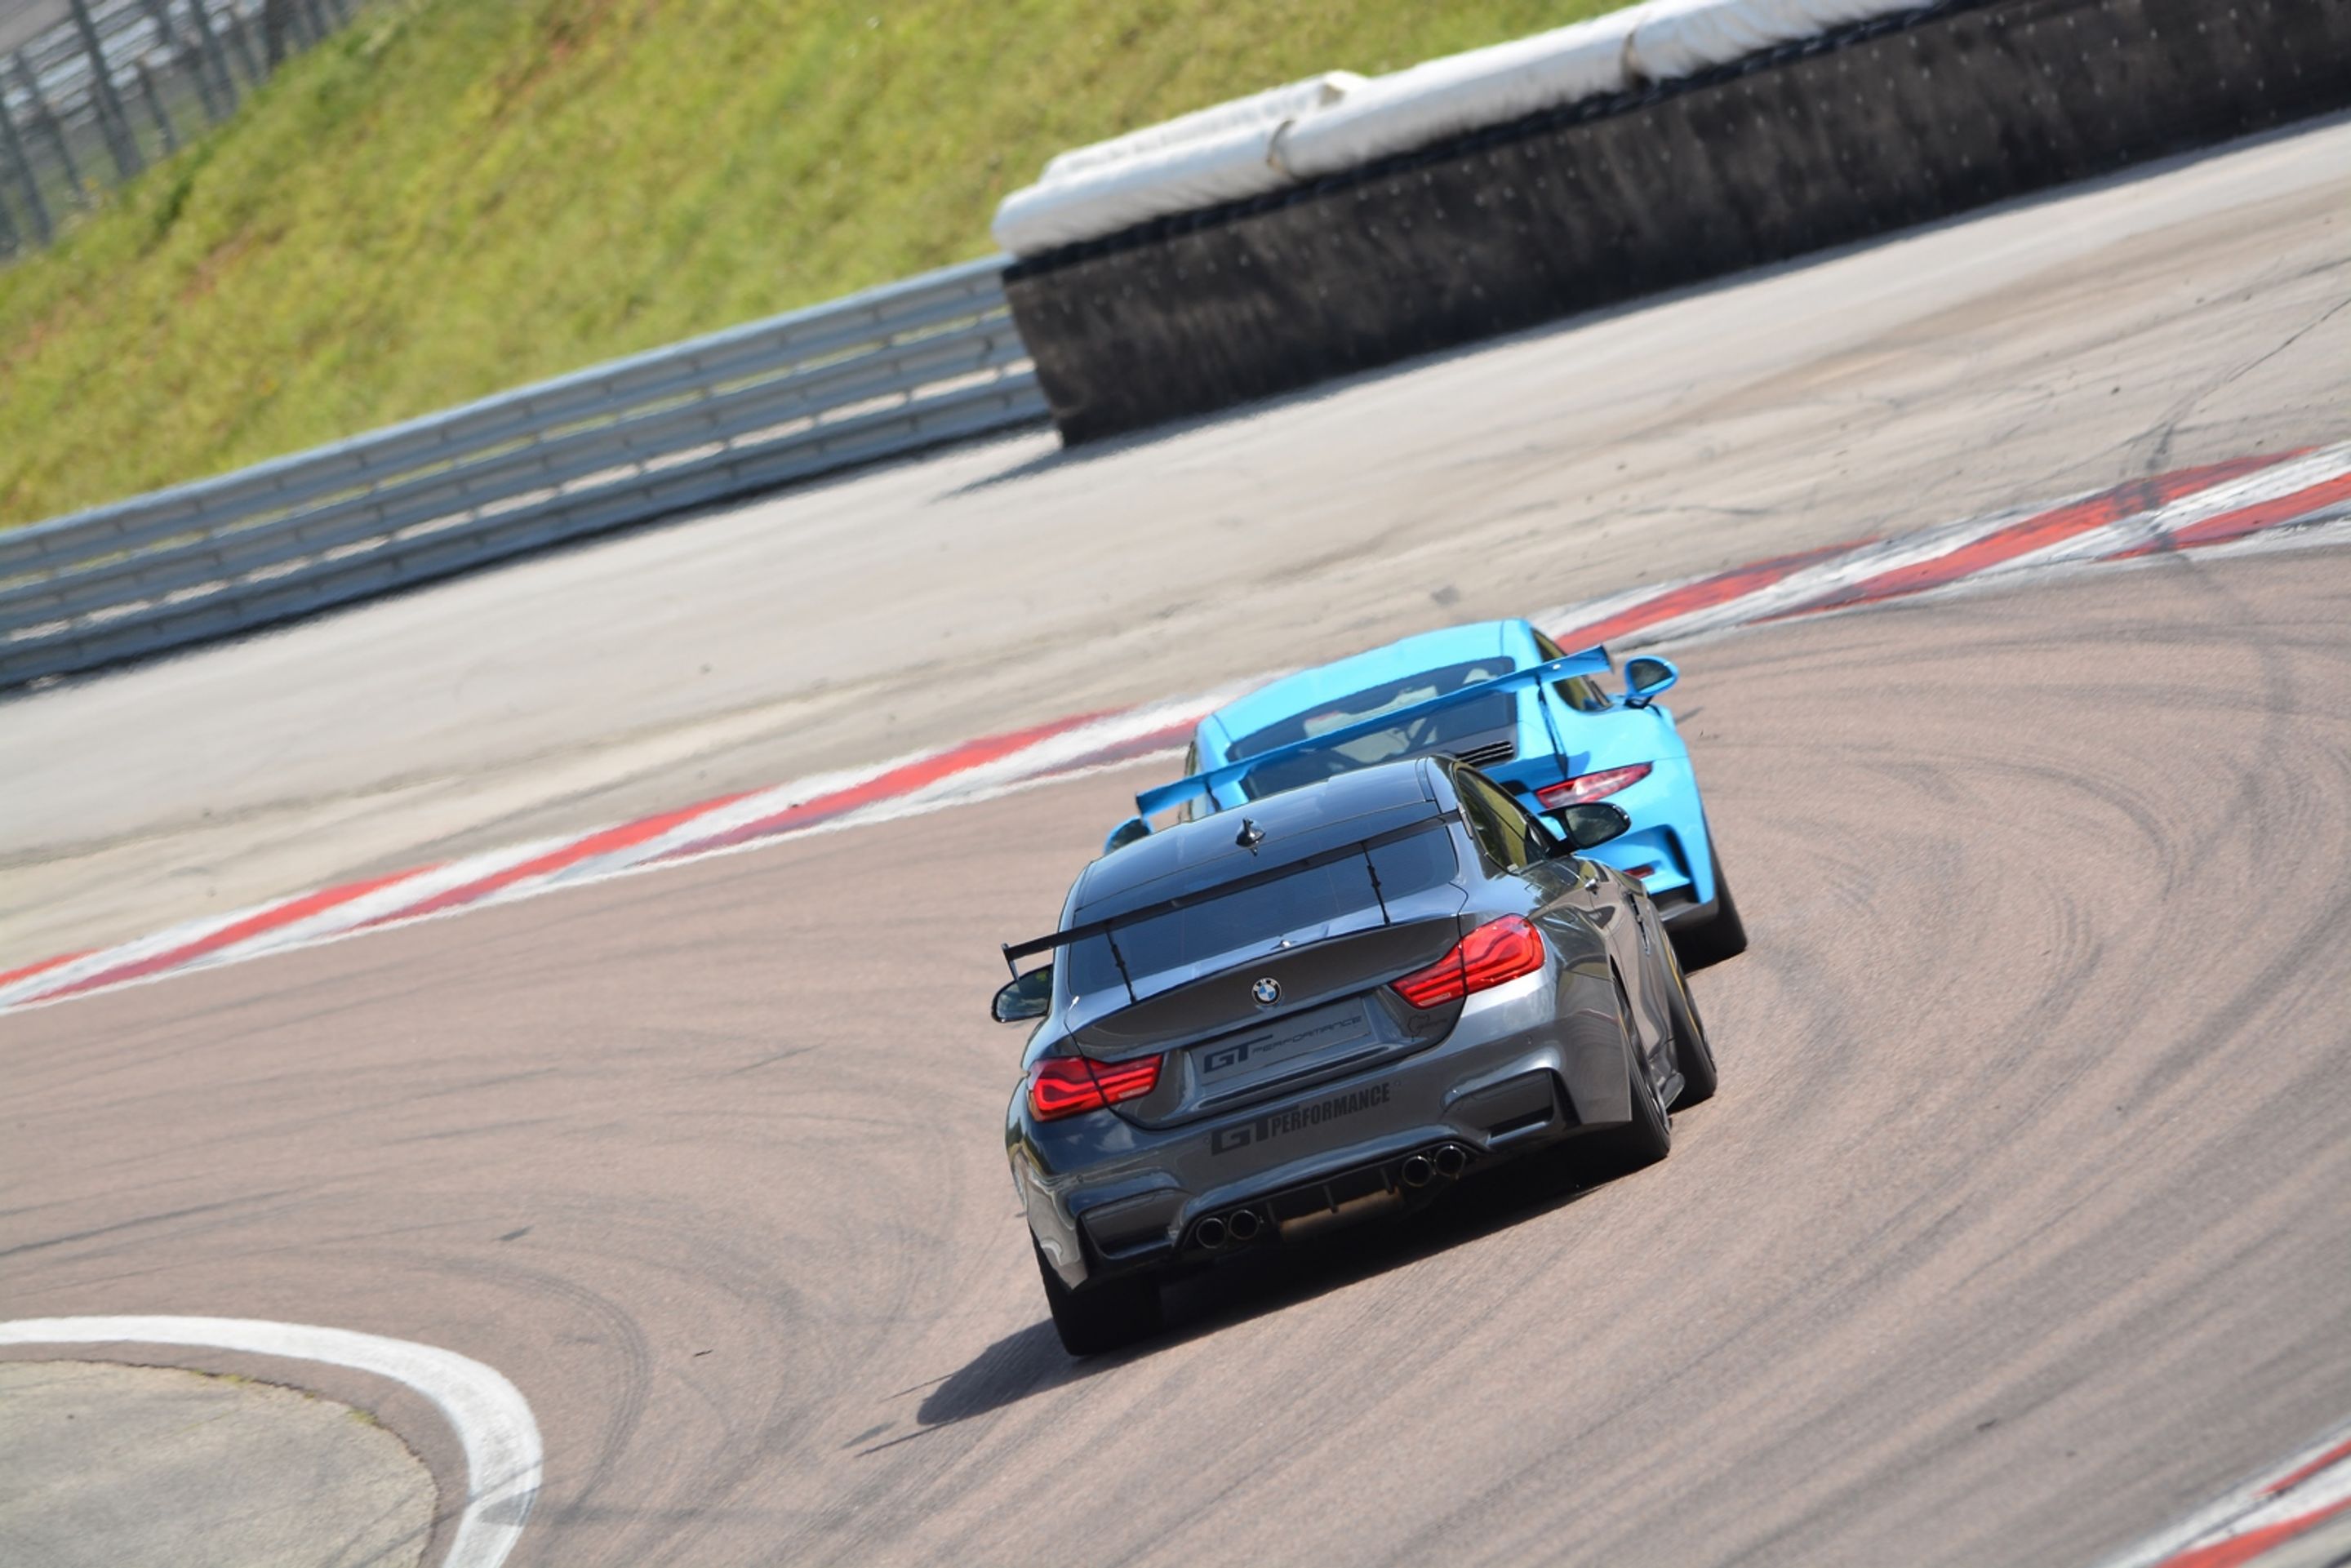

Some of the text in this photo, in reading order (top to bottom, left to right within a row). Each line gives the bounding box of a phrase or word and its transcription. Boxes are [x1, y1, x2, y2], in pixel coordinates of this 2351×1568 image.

[1204, 1034, 1273, 1073] GT
[1211, 1082, 1391, 1156] GT PERFORMANCE
